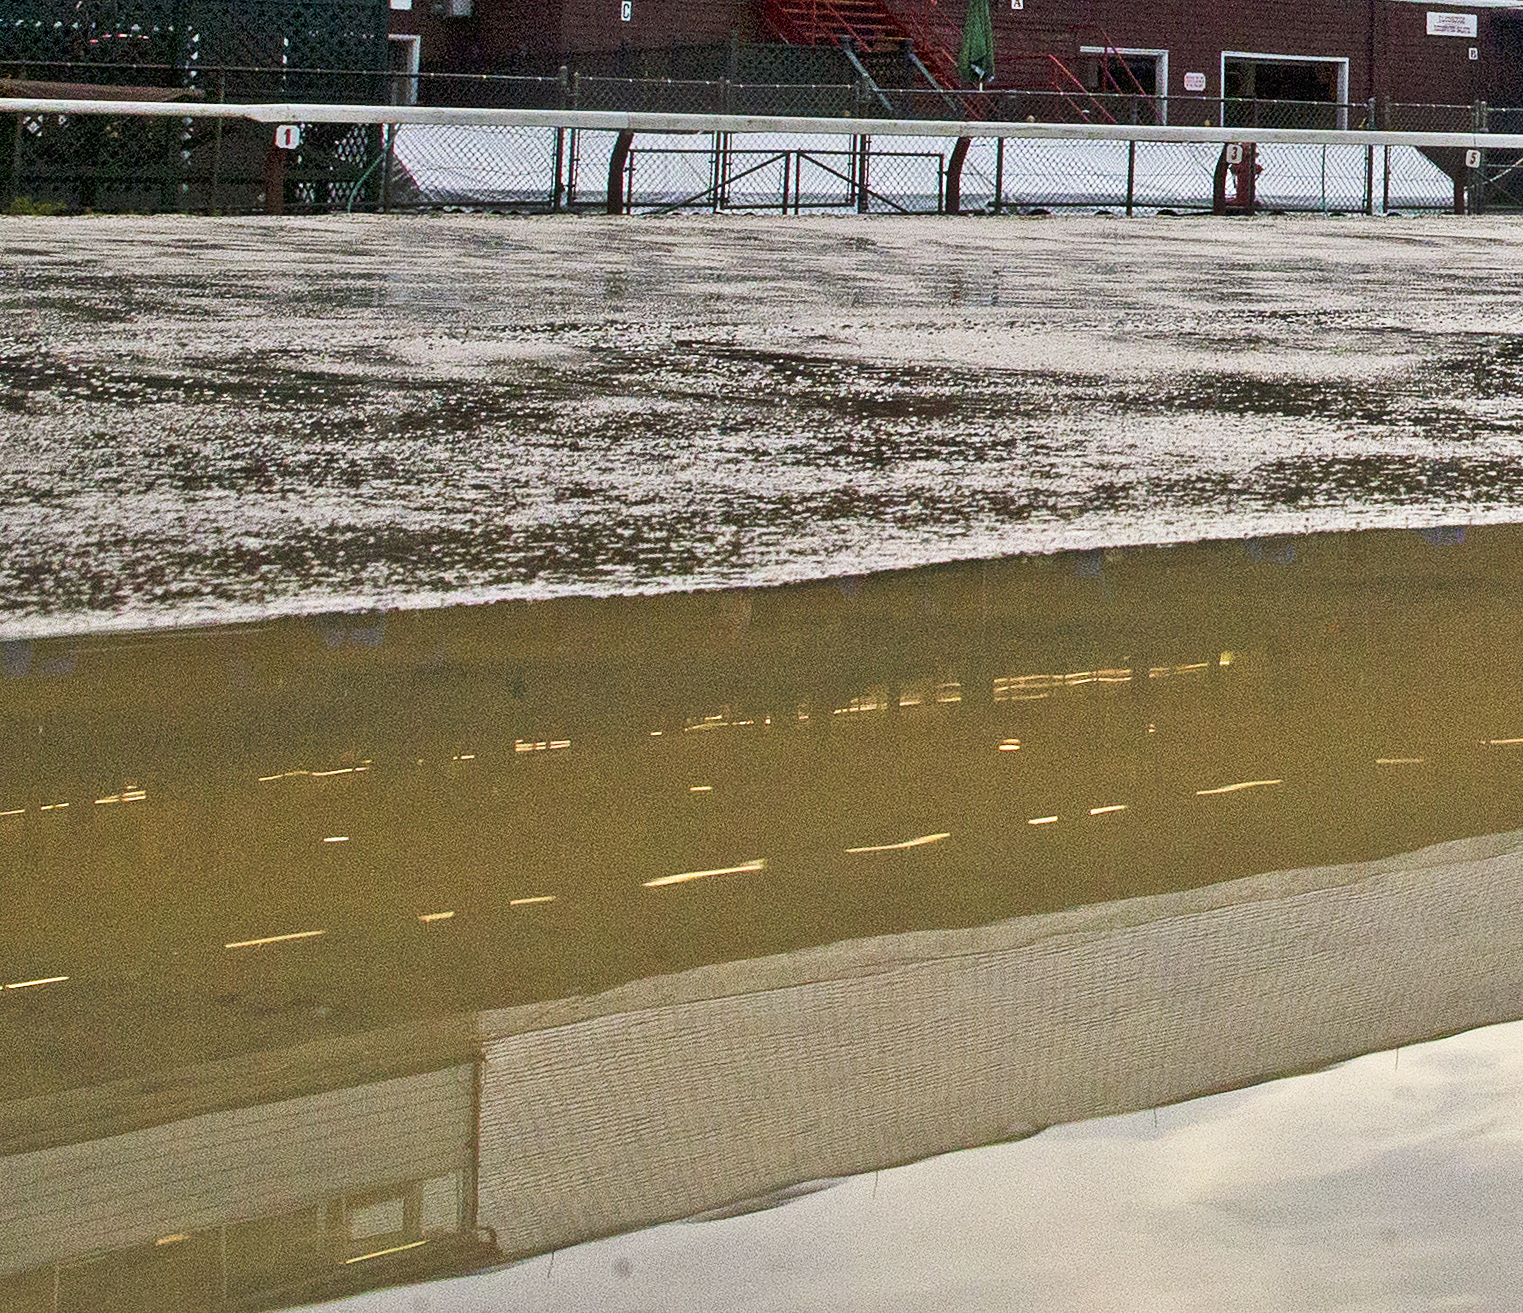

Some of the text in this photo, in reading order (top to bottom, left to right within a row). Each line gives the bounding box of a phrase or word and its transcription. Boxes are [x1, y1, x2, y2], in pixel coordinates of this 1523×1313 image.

[623, 3, 630, 18] C
[284, 128, 291, 145] 1
[1231, 146, 1238, 160] 3
[1469, 152, 1477, 164] 5
